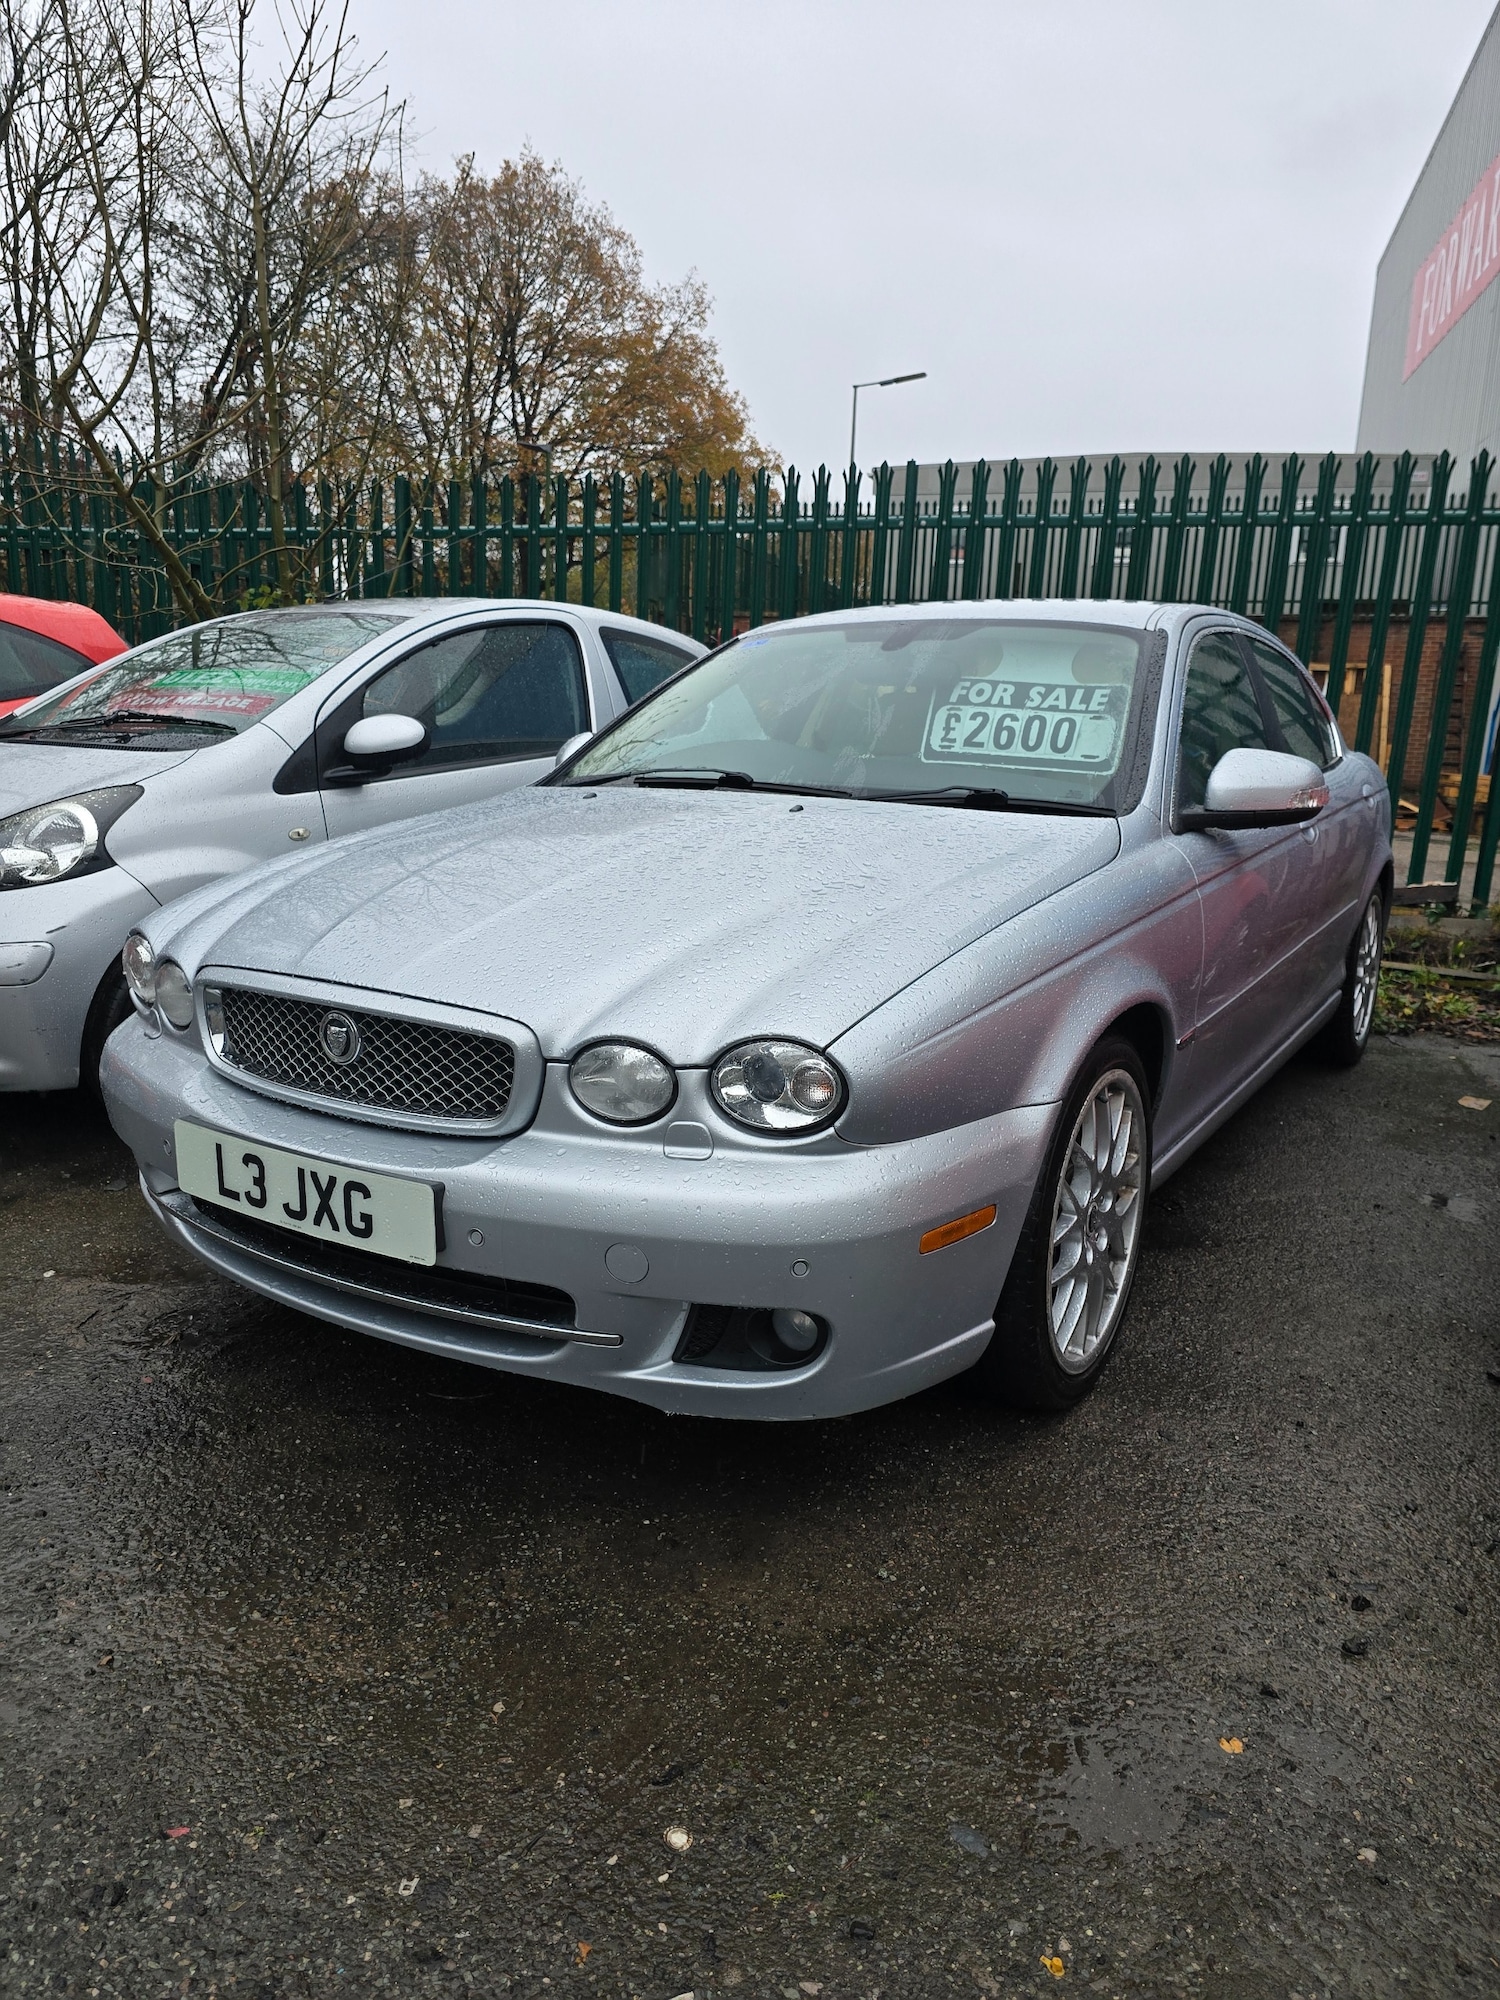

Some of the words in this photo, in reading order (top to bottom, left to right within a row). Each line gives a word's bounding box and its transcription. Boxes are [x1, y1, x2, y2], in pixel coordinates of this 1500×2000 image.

[130, 695, 172, 706] LOW
[173, 694, 254, 709] MILEAGE
[949, 681, 1016, 706] FOR
[1025, 686, 1111, 712] SALE
[940, 711, 1077, 754] £2600
[215, 1142, 267, 1209] L3
[282, 1166, 373, 1239] JXG
